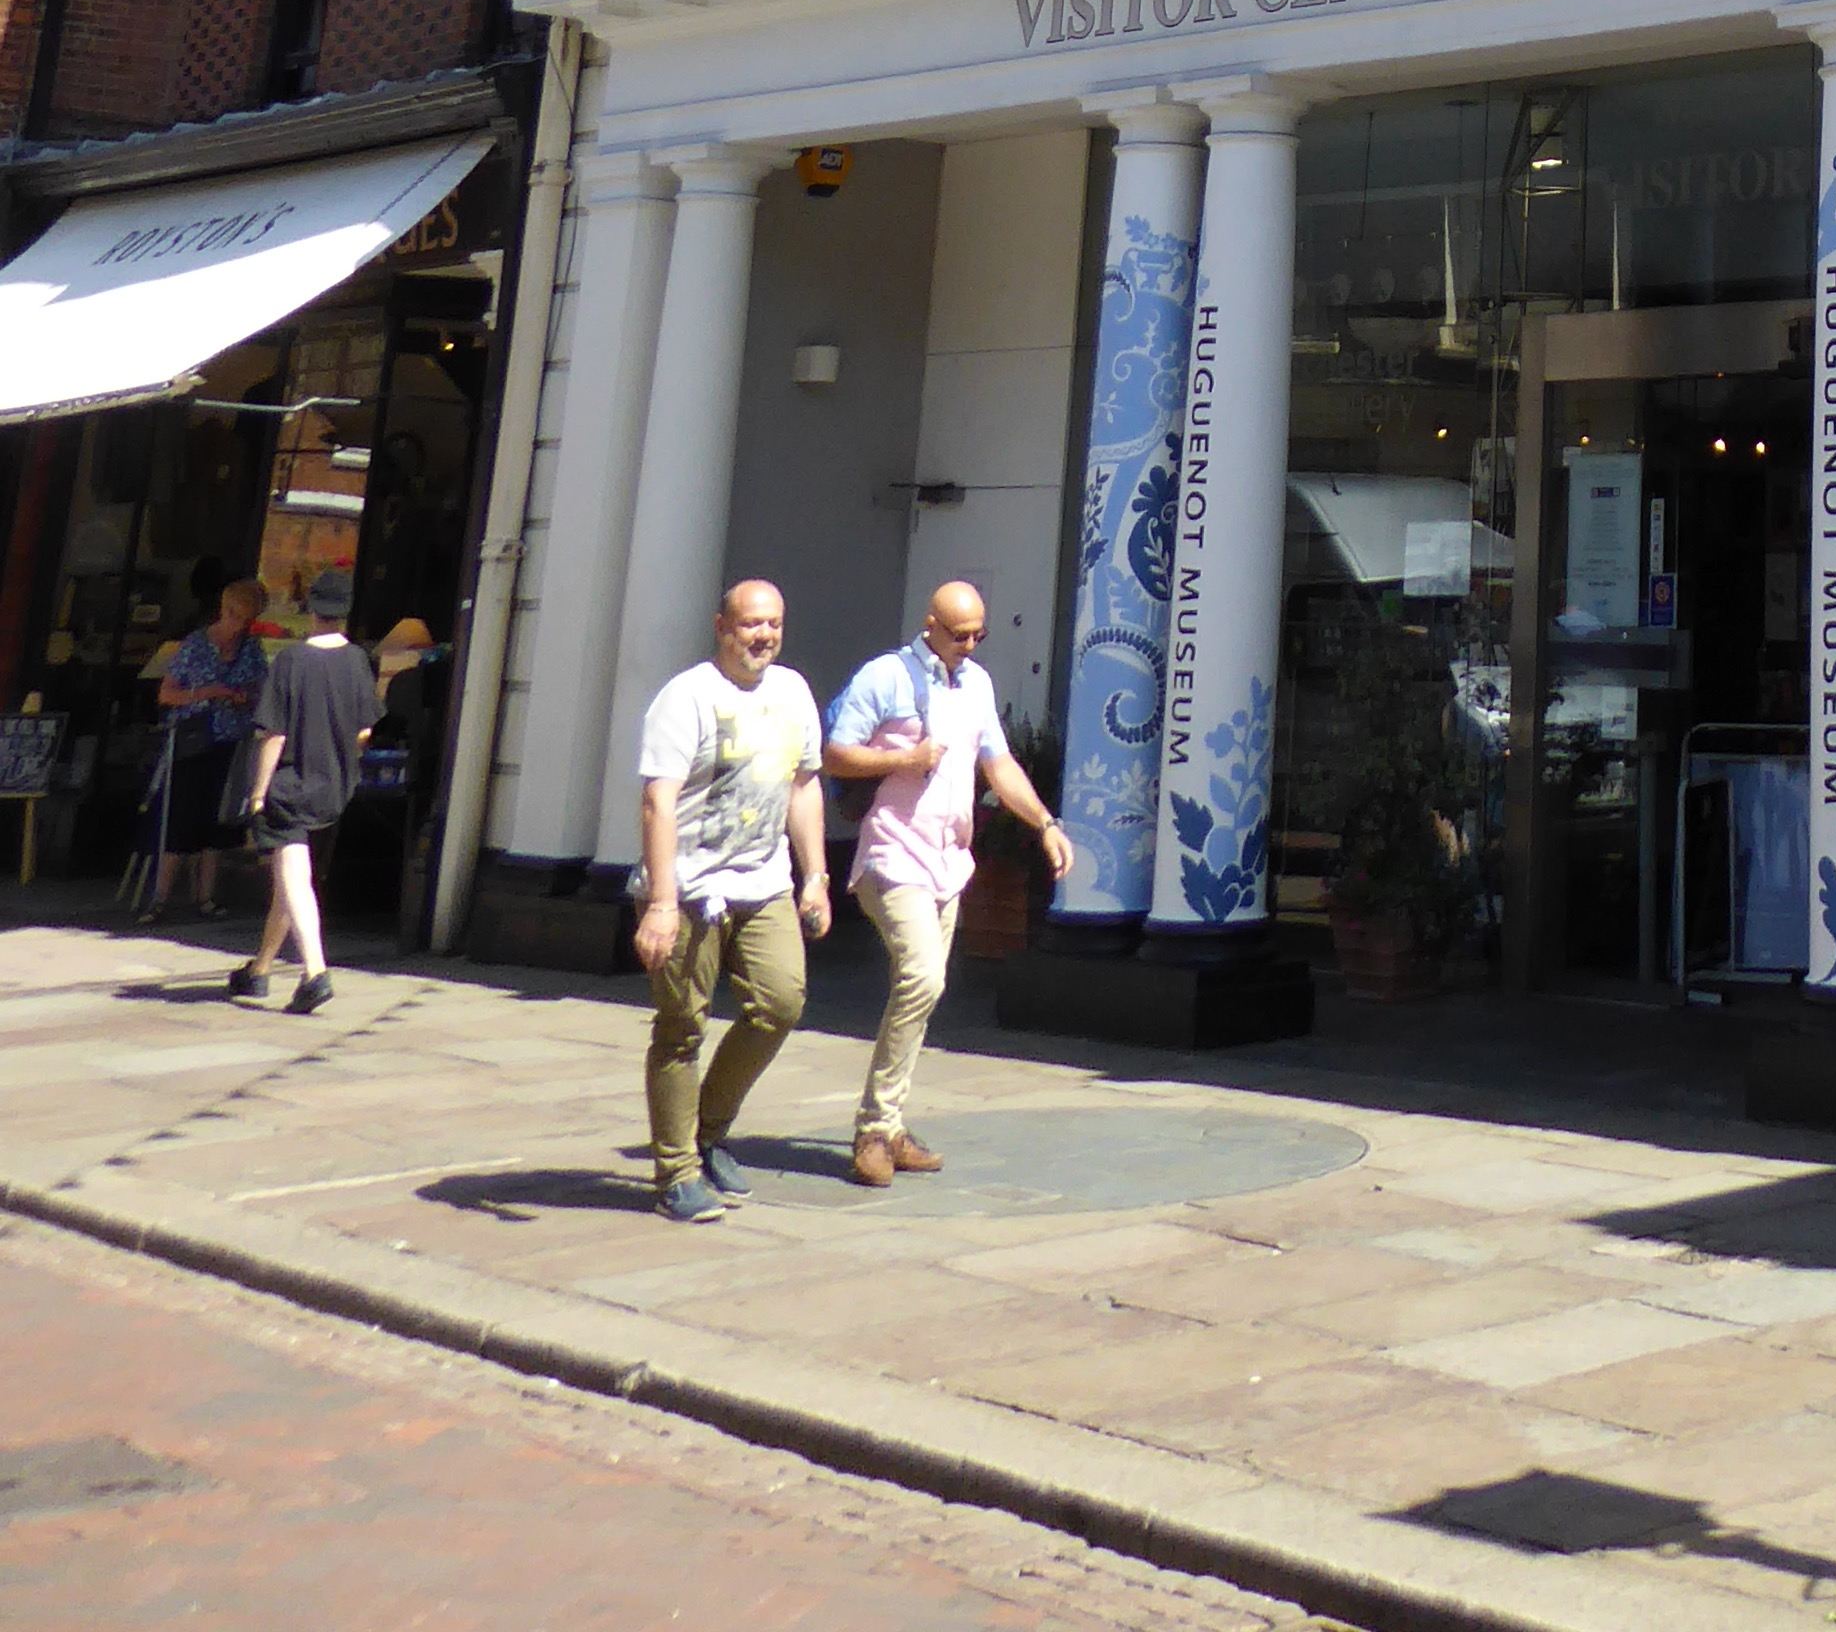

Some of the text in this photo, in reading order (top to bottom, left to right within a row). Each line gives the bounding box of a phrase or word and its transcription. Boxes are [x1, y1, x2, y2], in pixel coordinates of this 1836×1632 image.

[1625, 145, 1802, 210] ISITOR
[92, 201, 296, 266] ROYSTON'S
[1168, 304, 1219, 767] HUGUENOT MUSEUM
